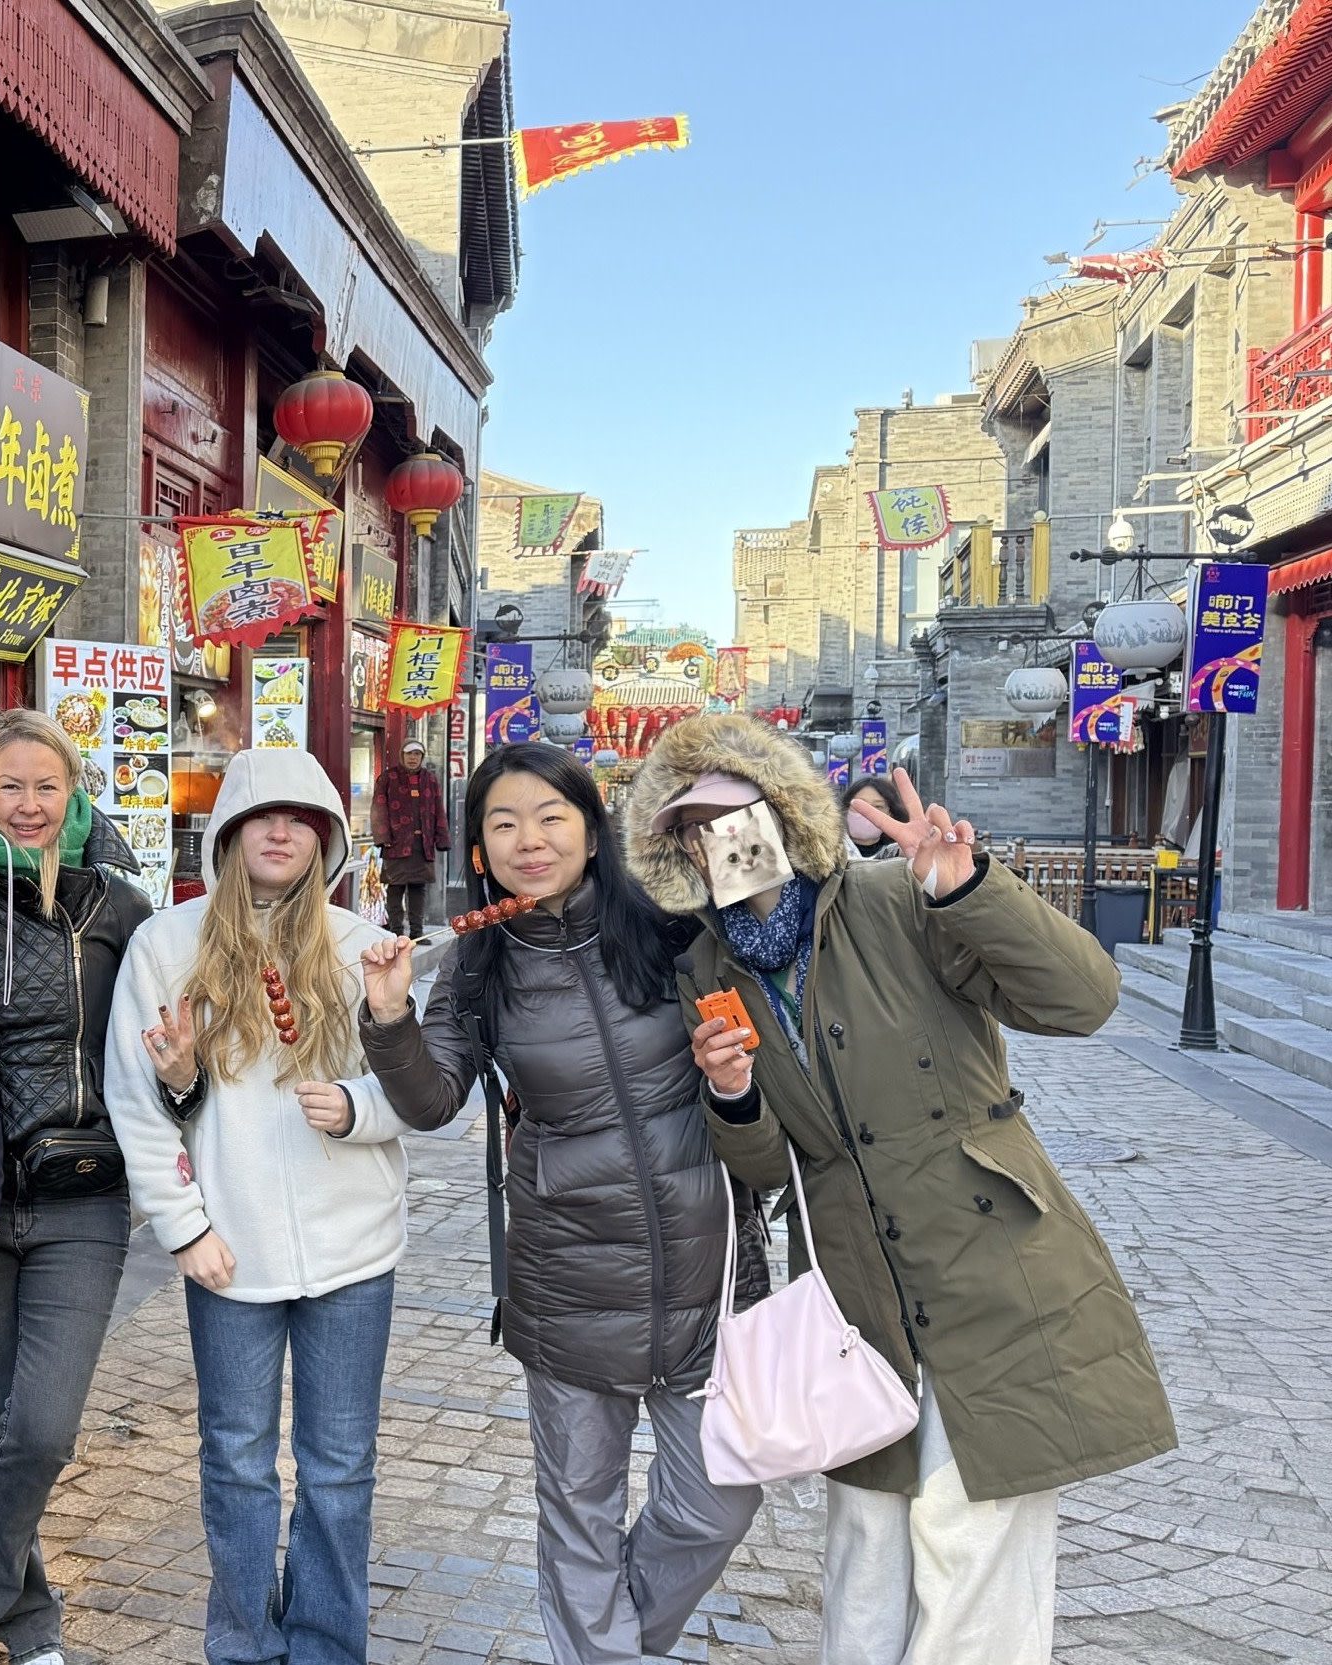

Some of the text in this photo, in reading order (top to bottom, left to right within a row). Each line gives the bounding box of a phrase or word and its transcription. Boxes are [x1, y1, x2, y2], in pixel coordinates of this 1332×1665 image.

[218, 538, 282, 628] 百年卤煮
[0, 625, 26, 648] Flavor
[53, 646, 165, 691] 早点供应
[400, 637, 444, 701] 门框卤煮
